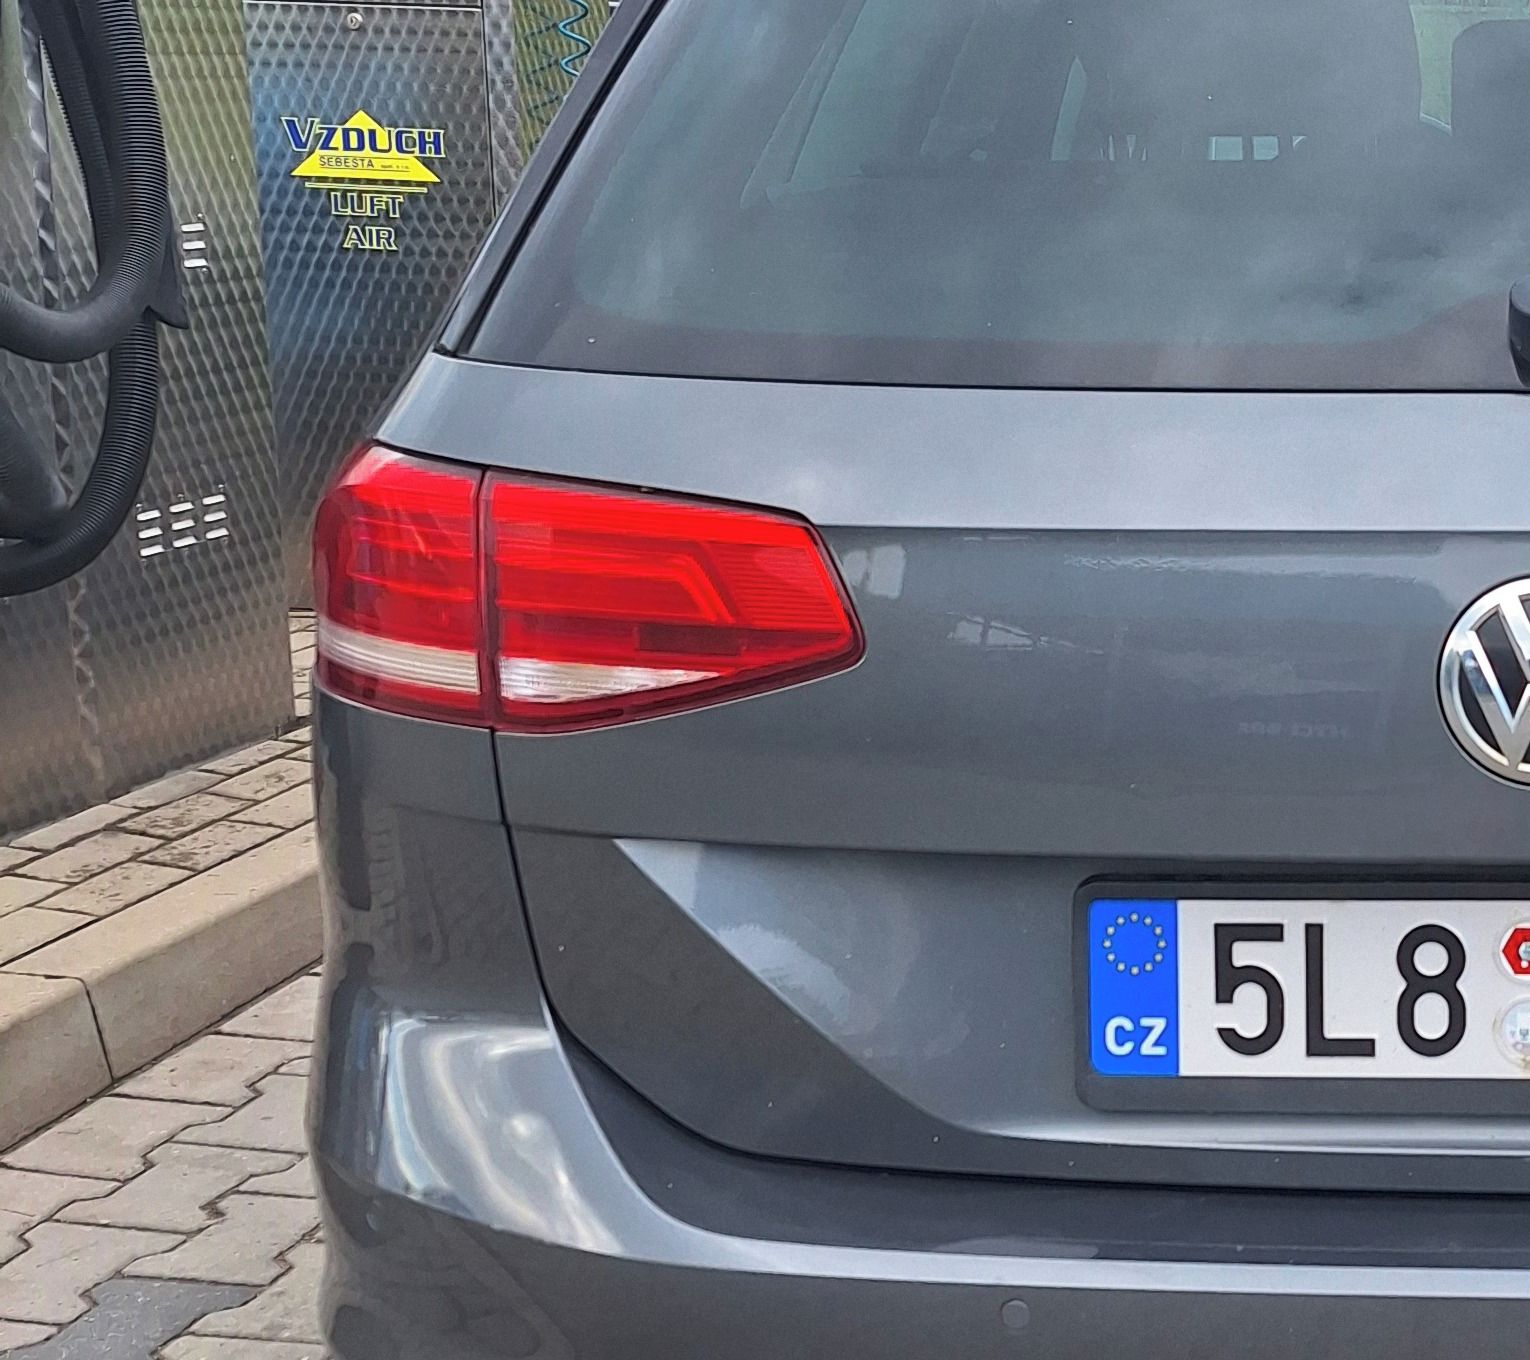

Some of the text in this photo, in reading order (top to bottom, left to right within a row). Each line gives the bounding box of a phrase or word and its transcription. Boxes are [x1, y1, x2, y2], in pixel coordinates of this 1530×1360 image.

[280, 116, 447, 158] VZDUCH
[330, 191, 404, 218] LUFT
[343, 225, 398, 250] AIR
[1213, 923, 1467, 1058] 5L8
[1104, 1016, 1168, 1057] CZ
